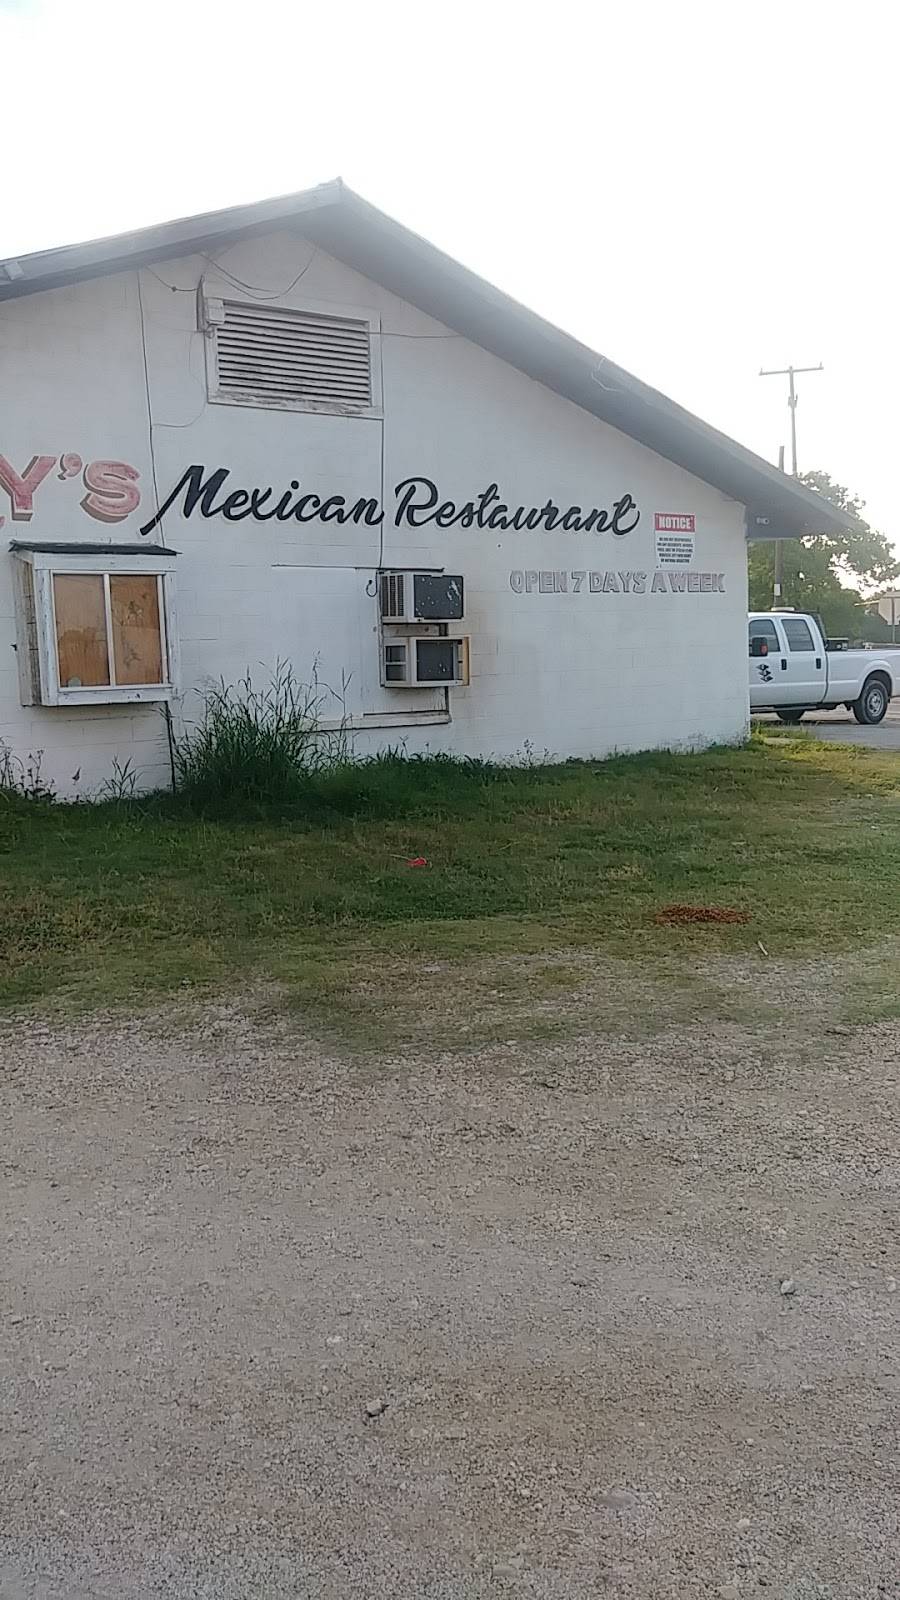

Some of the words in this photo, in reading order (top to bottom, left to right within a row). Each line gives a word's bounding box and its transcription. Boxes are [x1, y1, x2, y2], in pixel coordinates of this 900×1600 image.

[0, 453, 140, 525] Y'S
[140, 465, 384, 535] Mexican
[394, 477, 640, 536] Restaurant
[659, 516, 692, 530] NOTICE
[509, 570, 568, 594] OPEN
[571, 571, 587, 593] 7
[589, 572, 647, 594] DAYS
[651, 572, 668, 593] A
[668, 573, 726, 594] WEEK
